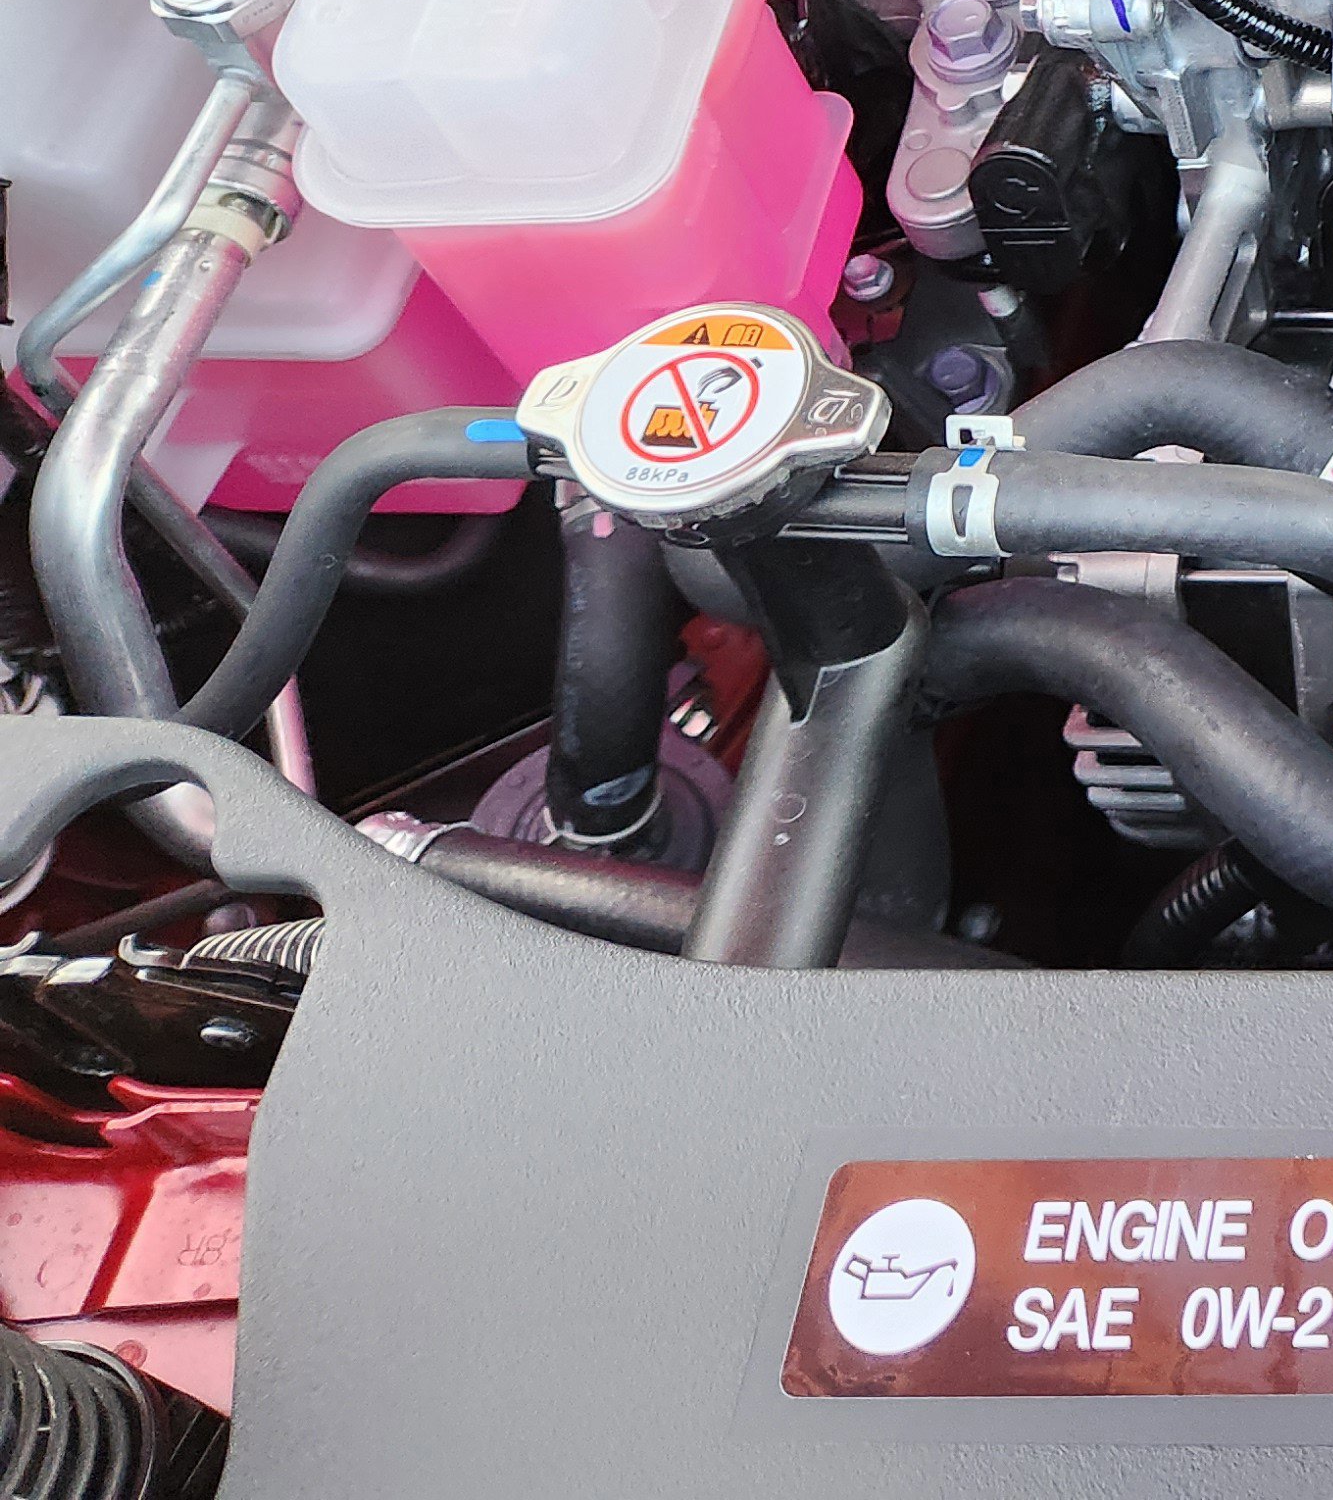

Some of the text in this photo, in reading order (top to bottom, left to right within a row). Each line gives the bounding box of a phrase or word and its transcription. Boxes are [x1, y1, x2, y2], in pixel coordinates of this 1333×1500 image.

[625, 466, 689, 483] 88kPa
[1023, 1199, 1253, 1263] ENGINE
[1006, 1285, 1140, 1353] SAE
